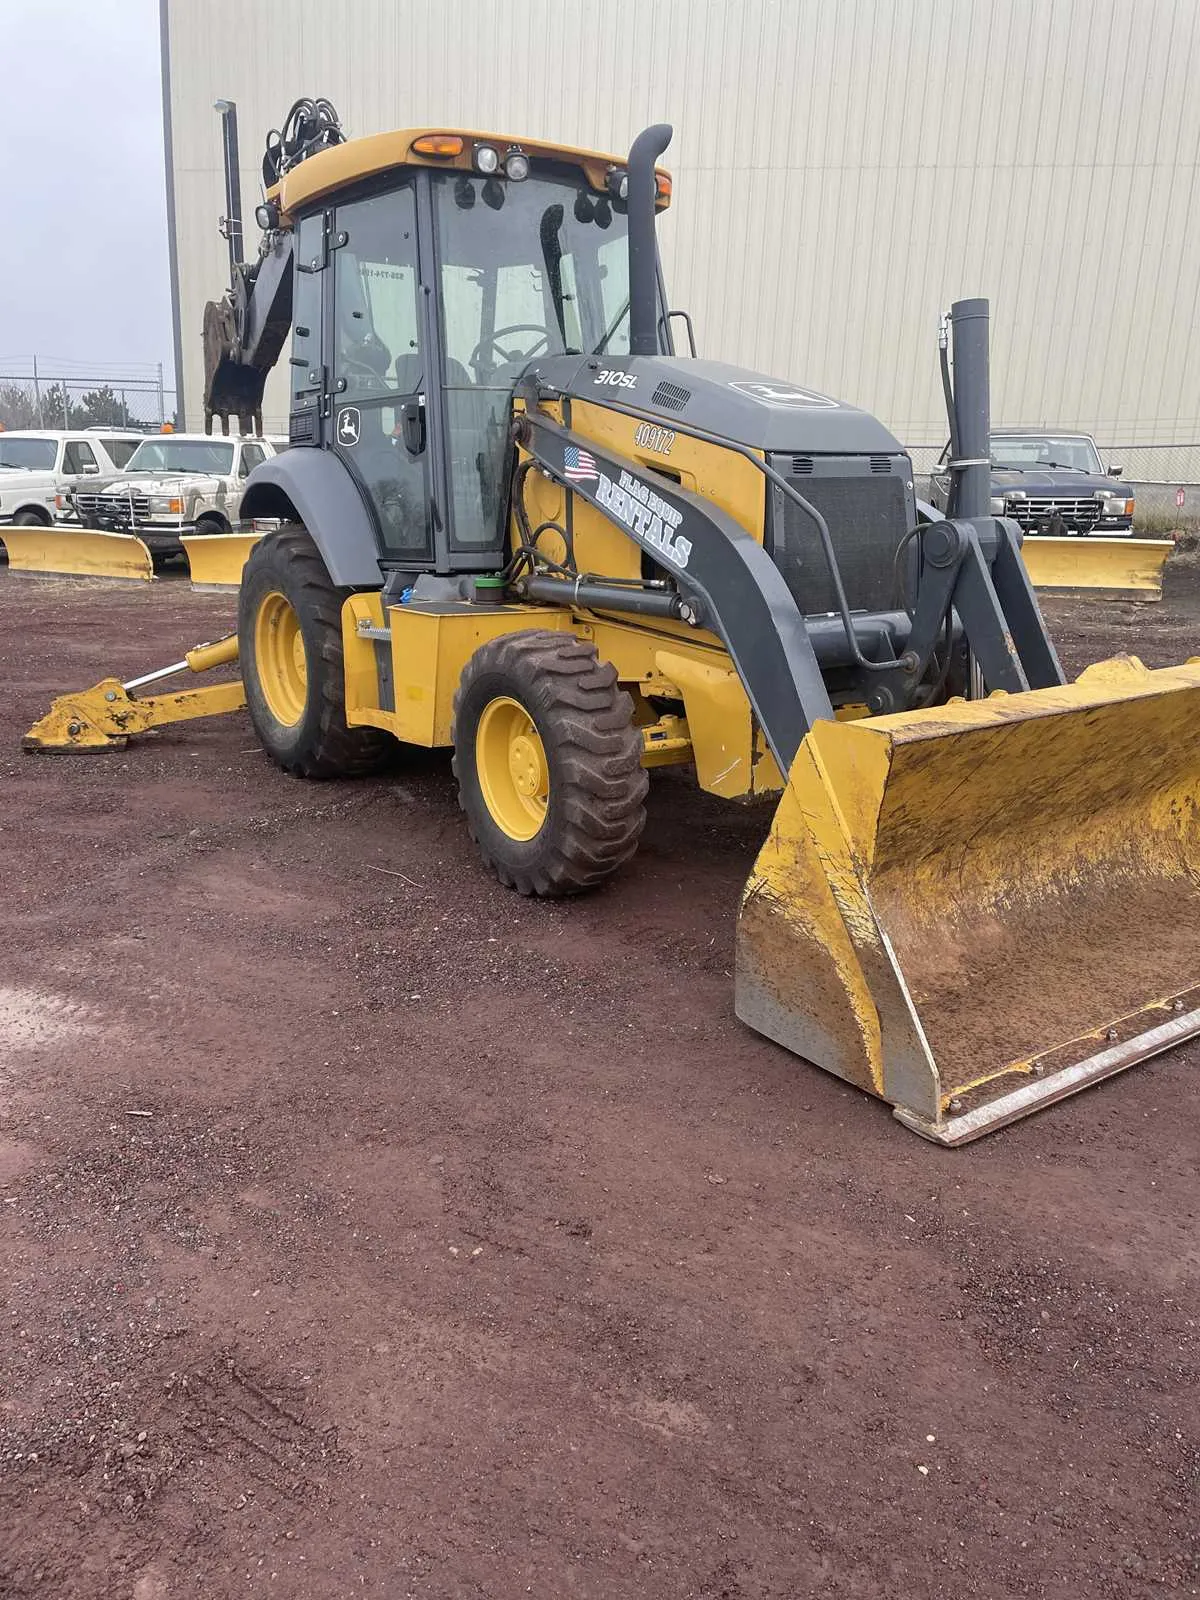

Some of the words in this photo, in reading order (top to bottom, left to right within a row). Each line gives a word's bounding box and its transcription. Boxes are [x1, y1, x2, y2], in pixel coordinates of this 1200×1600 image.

[594, 370, 638, 389] 310SL
[635, 422, 675, 455] 409172
[595, 472, 693, 568] RENTALS
[619, 469, 650, 504] FLAG
[646, 490, 683, 529] EQUIP
